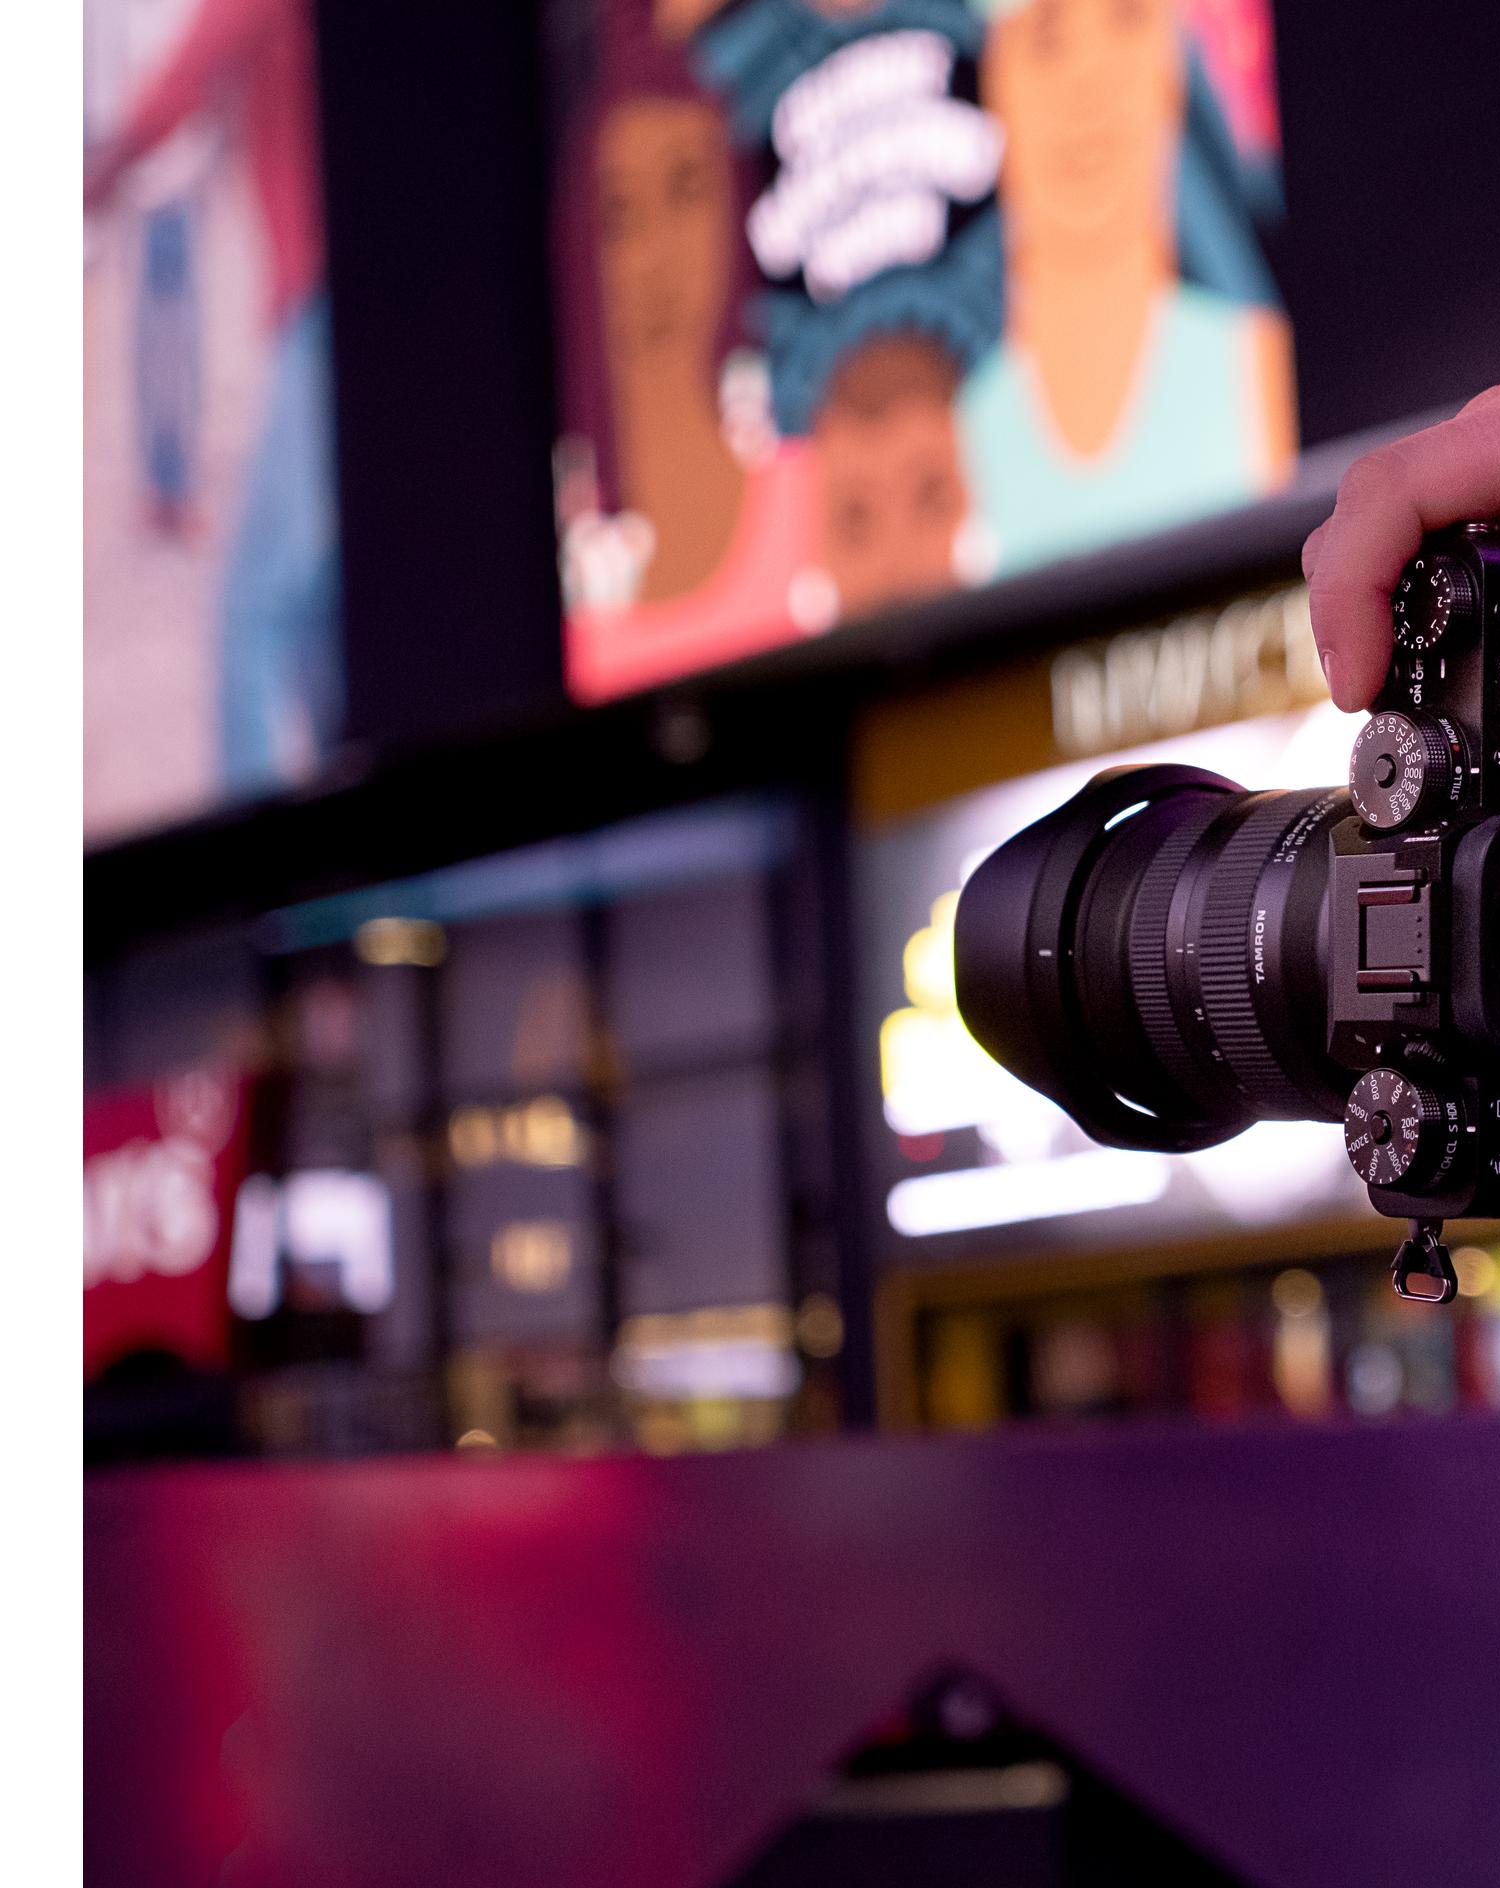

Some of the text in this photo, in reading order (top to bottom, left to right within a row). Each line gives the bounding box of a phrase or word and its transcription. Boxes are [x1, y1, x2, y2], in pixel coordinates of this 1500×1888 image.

[1415, 657, 1424, 681] OFF
[1413, 684, 1422, 704] ON
[1365, 725, 1375, 740] 15
[1376, 718, 1385, 734] 30
[1388, 717, 1397, 733] 60
[1395, 723, 1409, 744] 125
[1438, 718, 1459, 744] MOVIE
[1356, 738, 1364, 749] 8
[1351, 754, 1357, 765] 4
[1405, 749, 1422, 766] 500
[1350, 773, 1356, 784] 2
[1404, 767, 1422, 779] 1000
[1353, 790, 1359, 800] 1
[1401, 778, 1420, 797] 2000
[1450, 774, 1463, 801] STILL
[1358, 801, 1368, 813] T
[1395, 788, 1412, 811] 4000
[1389, 795, 1402, 822] 8000
[1369, 812, 1378, 823] B
[1255, 909, 1267, 985] TAMRON
[1369, 1079, 1380, 1101] 800
[1391, 1084, 1403, 1105] 400
[1350, 1103, 1368, 1122] 1600
[1446, 1102, 1458, 1121] HDR
[1400, 1117, 1415, 1128] 200
[1448, 1124, 1459, 1133] S
[1350, 1132, 1370, 1152] 3200
[1402, 1128, 1415, 1141] 160
[1446, 1140, 1458, 1154] CL
[1368, 1148, 1380, 1177] 6400
[1385, 1142, 1401, 1172] 12800
[1400, 1154, 1409, 1165] C
[1440, 1156, 1453, 1170] CH
